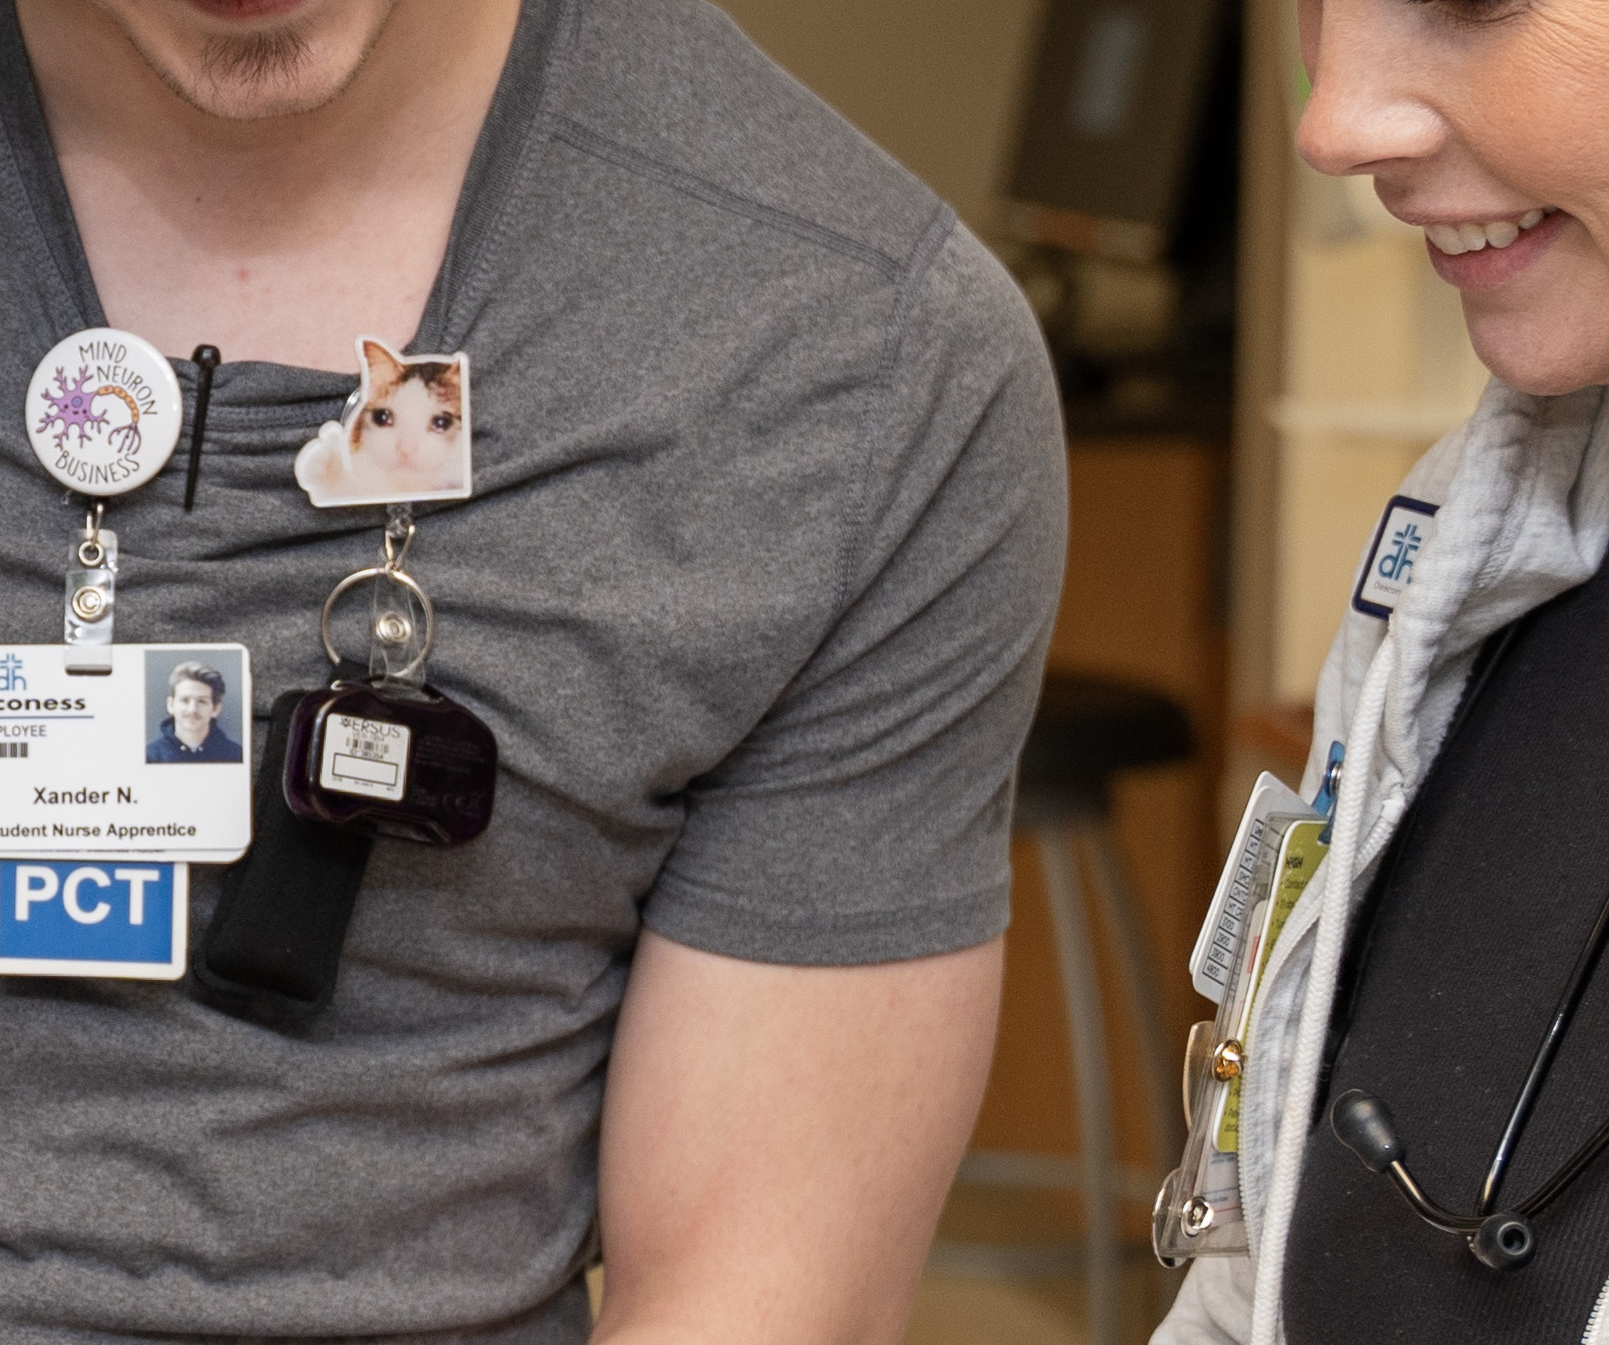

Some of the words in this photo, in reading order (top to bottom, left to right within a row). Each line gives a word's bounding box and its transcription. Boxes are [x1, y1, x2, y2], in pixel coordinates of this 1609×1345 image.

[78, 340, 127, 364] MIND
[96, 364, 158, 415] NEURON
[54, 450, 141, 484] BUSINESS
[32, 786, 110, 805] Xander
[116, 786, 138, 805] N.
[52, 823, 101, 838] Nurse
[106, 822, 197, 840] Apprentice
[14, 865, 160, 925] PCT
